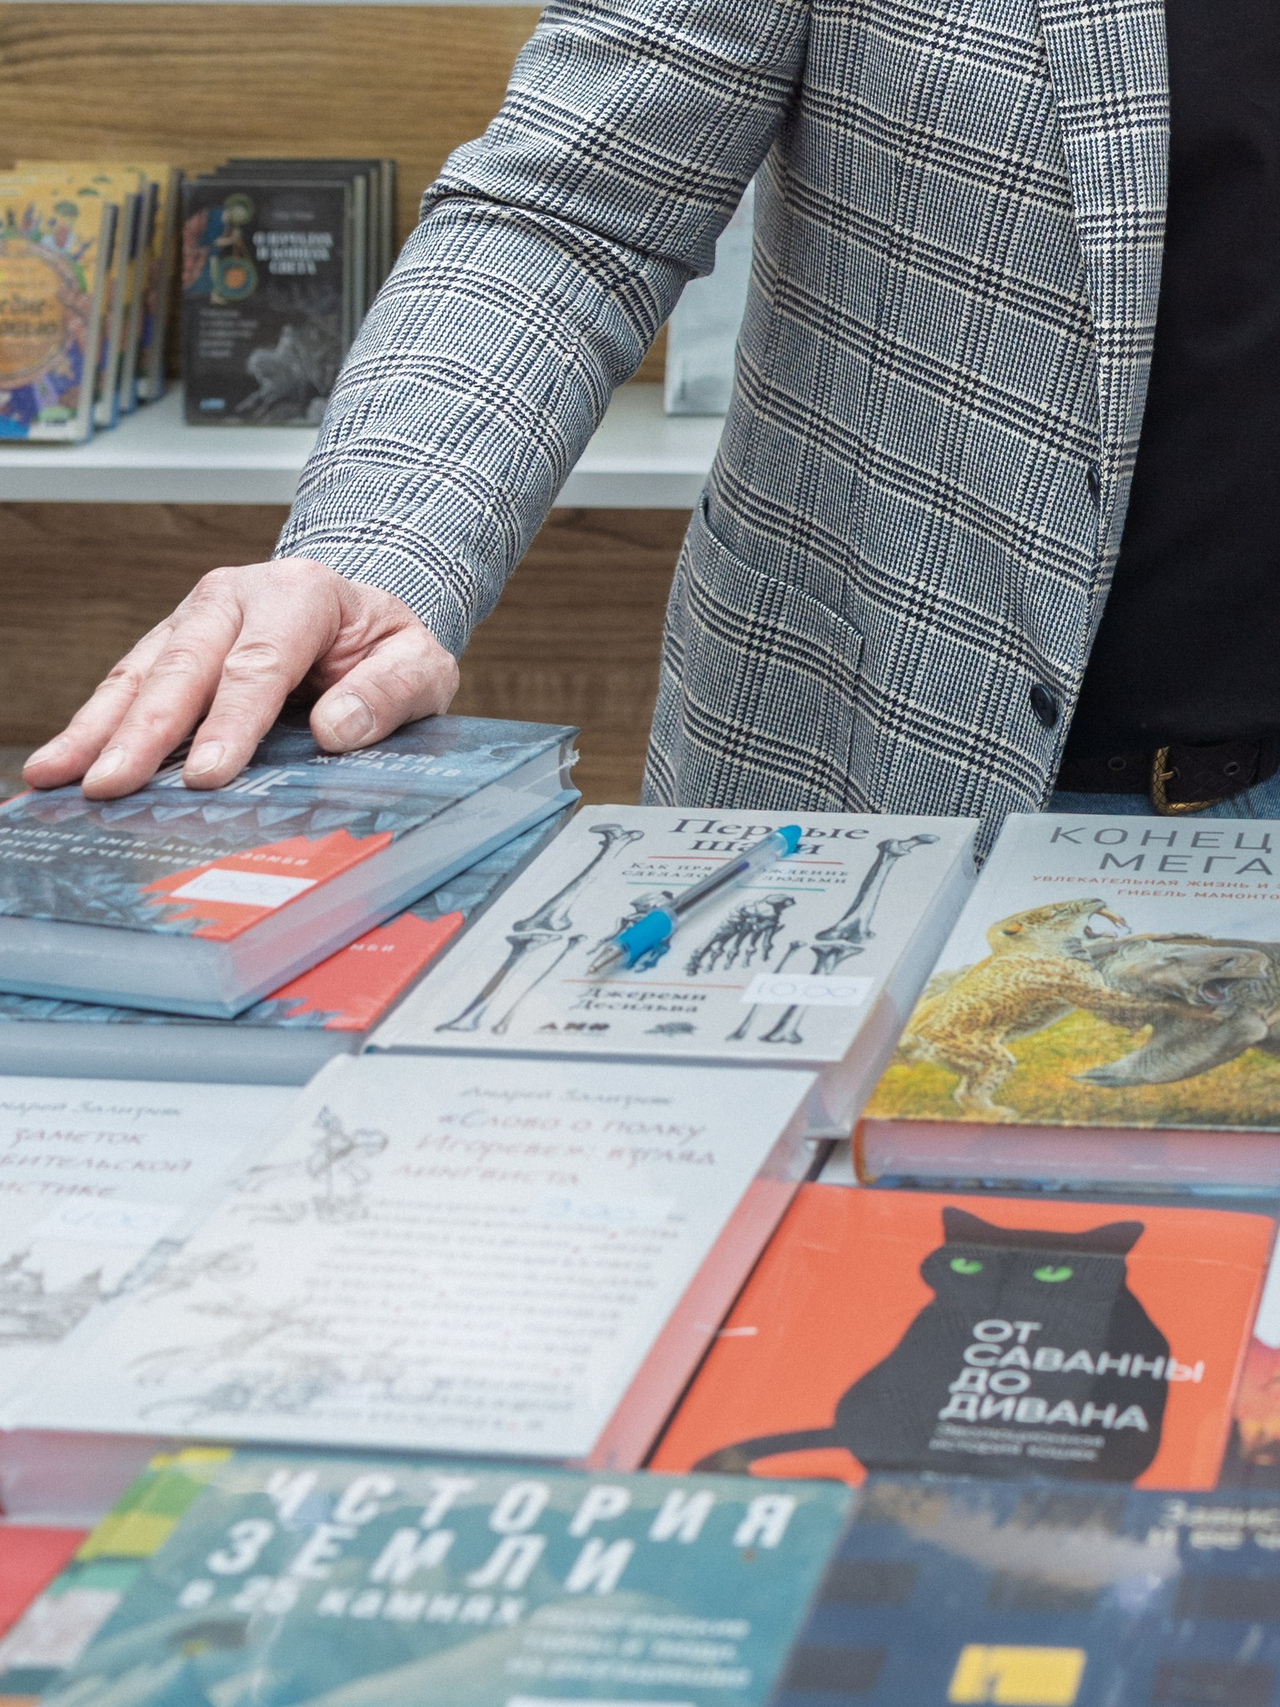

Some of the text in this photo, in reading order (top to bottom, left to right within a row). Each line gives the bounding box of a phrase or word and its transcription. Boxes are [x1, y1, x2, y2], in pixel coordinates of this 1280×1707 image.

[341, 749, 436, 764] НДРЕЙ
[668, 817, 871, 841] Перые
[1050, 826, 1272, 854] КОНЕЦ
[0, 838, 64, 852] РУГИЕ
[689, 839, 825, 856] шаи
[1032, 875, 1180, 887] УВЛЕКАТЕЛЬНАЯ
[1186, 880, 1250, 889] ЖИЗНЬ
[1258, 882, 1269, 890] И
[1117, 888, 1187, 898] ГИБЕЛЬ
[972, 1319, 1042, 1344] ОТ
[962, 1342, 1205, 1383] САВАННЫ
[948, 1367, 1031, 1395] ДО
[937, 1393, 1149, 1432] ДИВАНА
[206, 1519, 637, 1594] ЗЕМЛИ
